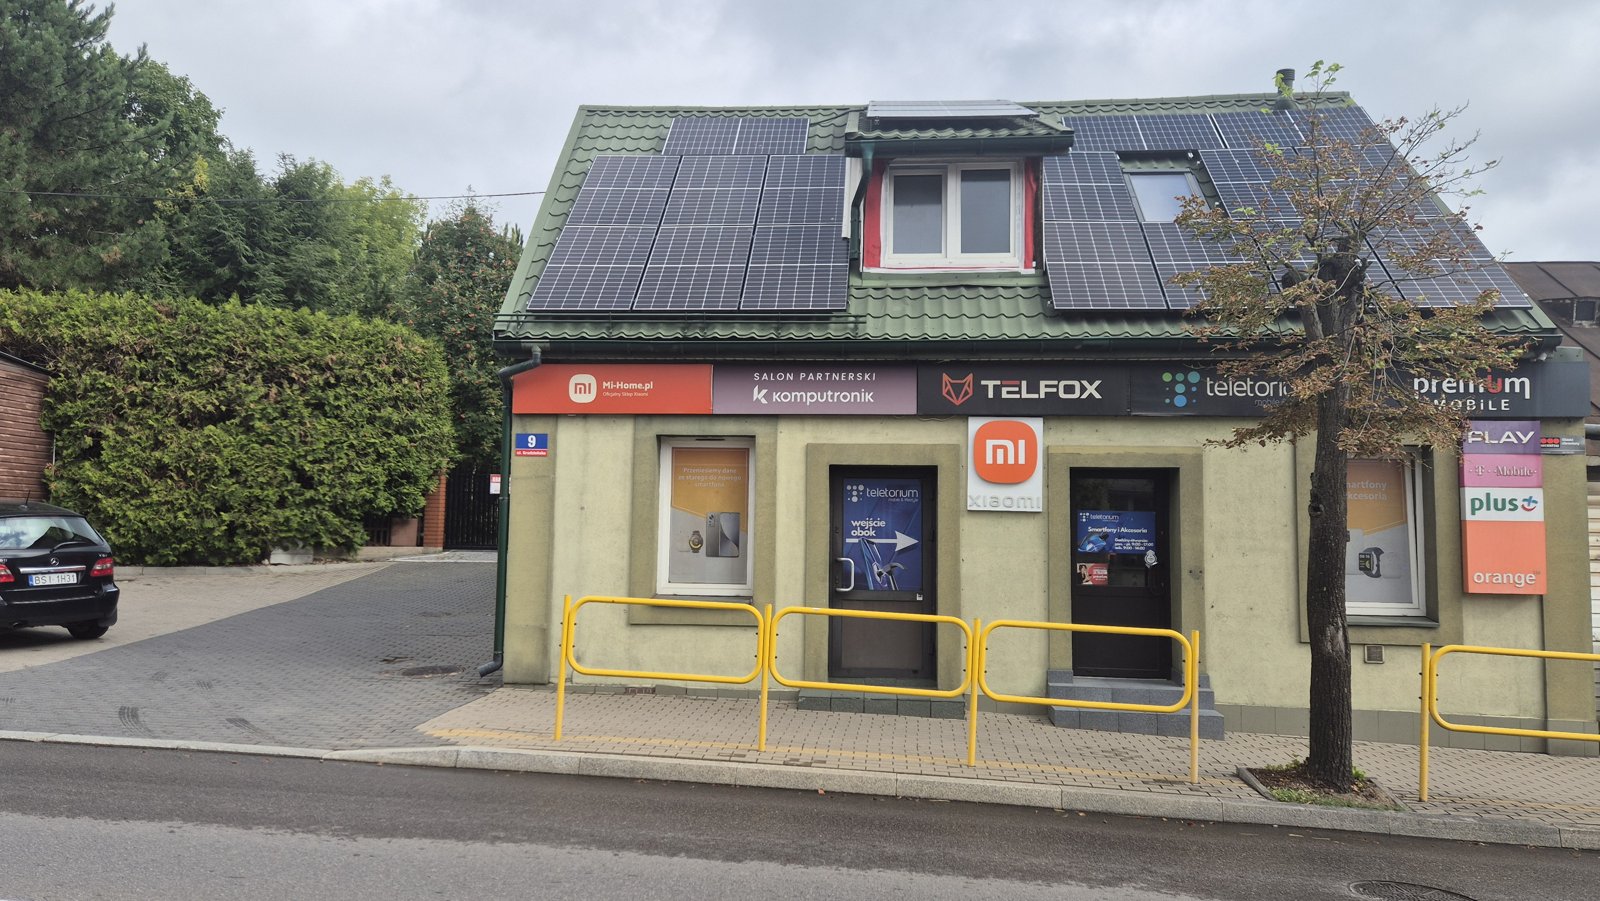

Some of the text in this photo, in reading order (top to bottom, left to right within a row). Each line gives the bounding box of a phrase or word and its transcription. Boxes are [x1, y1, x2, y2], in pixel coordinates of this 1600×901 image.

[753, 372, 877, 381] SALON PARTNERSKI
[602, 381, 654, 392] Mi-Home.pl
[980, 380, 1102, 399] TELFOX
[772, 388, 874, 406] komputronik
[527, 434, 537, 448] 9
[1467, 430, 1535, 444] PLAY
[866, 487, 919, 498] teletorium
[1470, 492, 1519, 516] plus
[851, 517, 886, 529] wejście
[851, 526, 876, 537] obok
[1088, 526, 1117, 534] Smartfony
[57, 574, 75, 583] 1H31
[1473, 571, 1536, 588] orange
